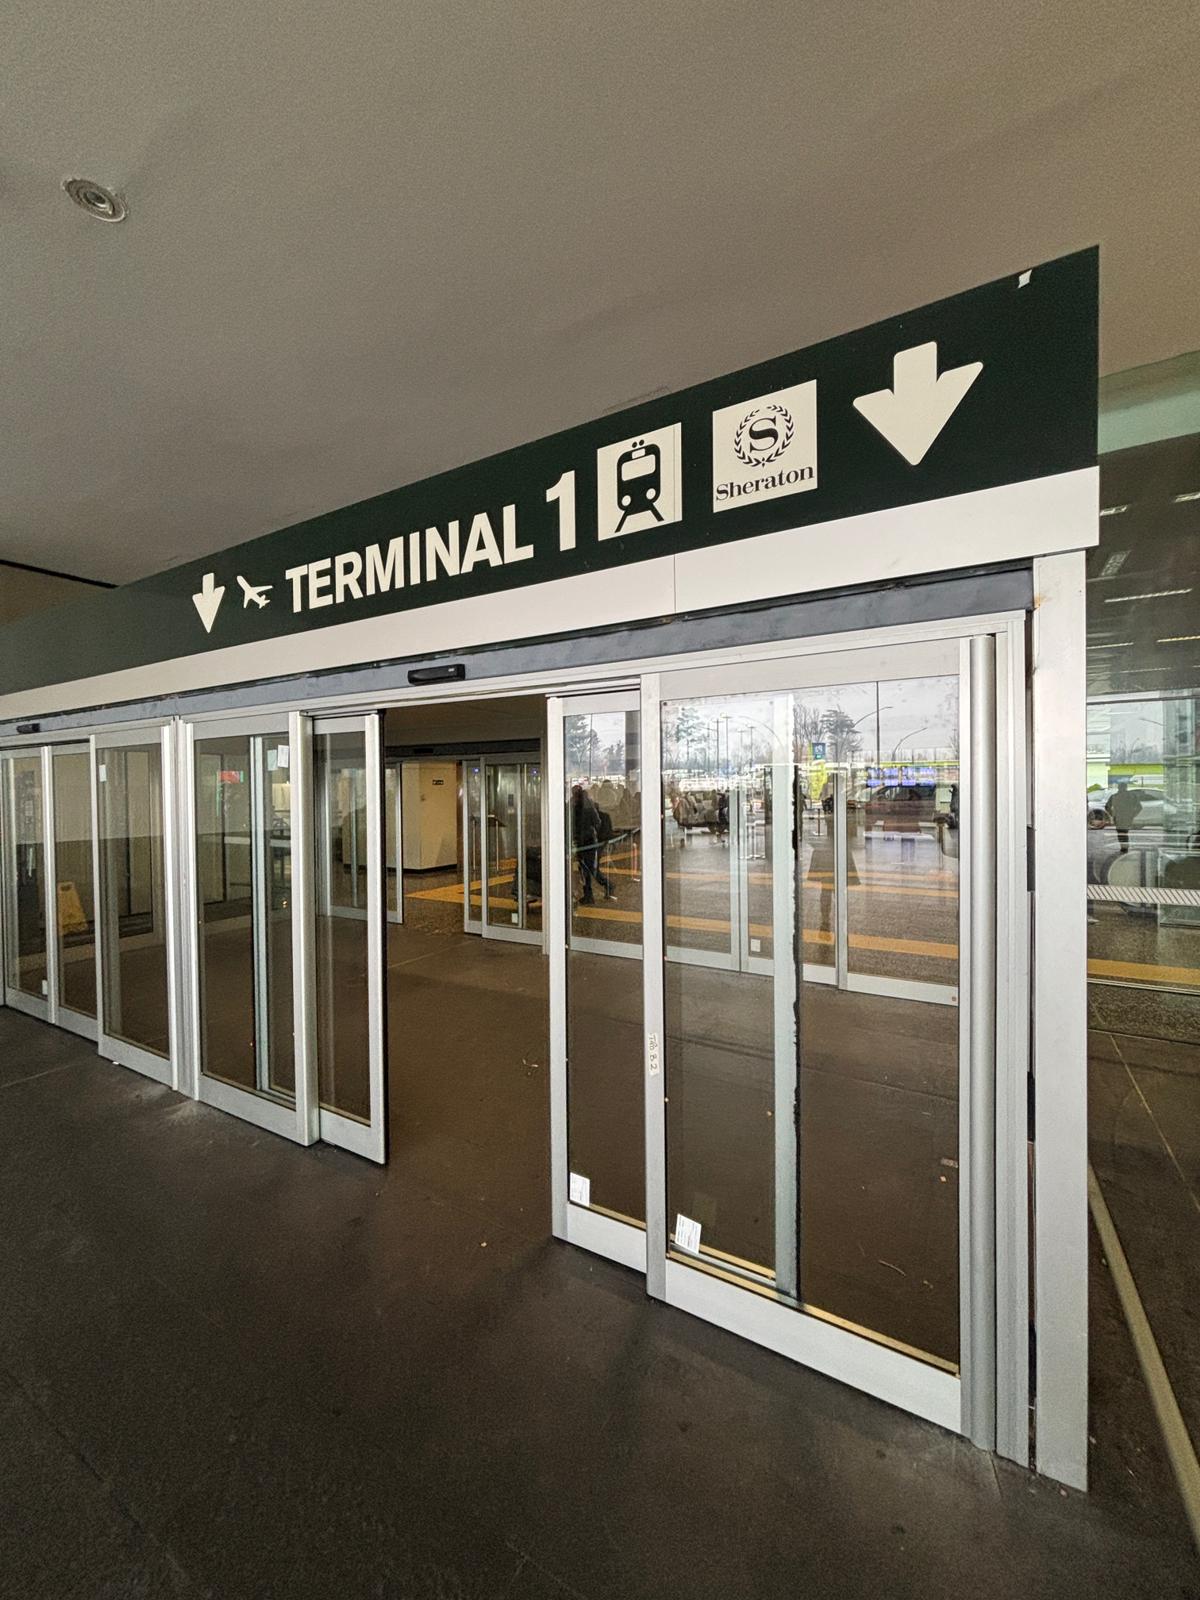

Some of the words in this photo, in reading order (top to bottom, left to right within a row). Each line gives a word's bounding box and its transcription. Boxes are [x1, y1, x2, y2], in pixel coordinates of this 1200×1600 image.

[748, 416, 779, 453] S
[715, 466, 815, 501] Sheraton
[285, 504, 534, 613] TERMINAL
[546, 470, 576, 552] 1
